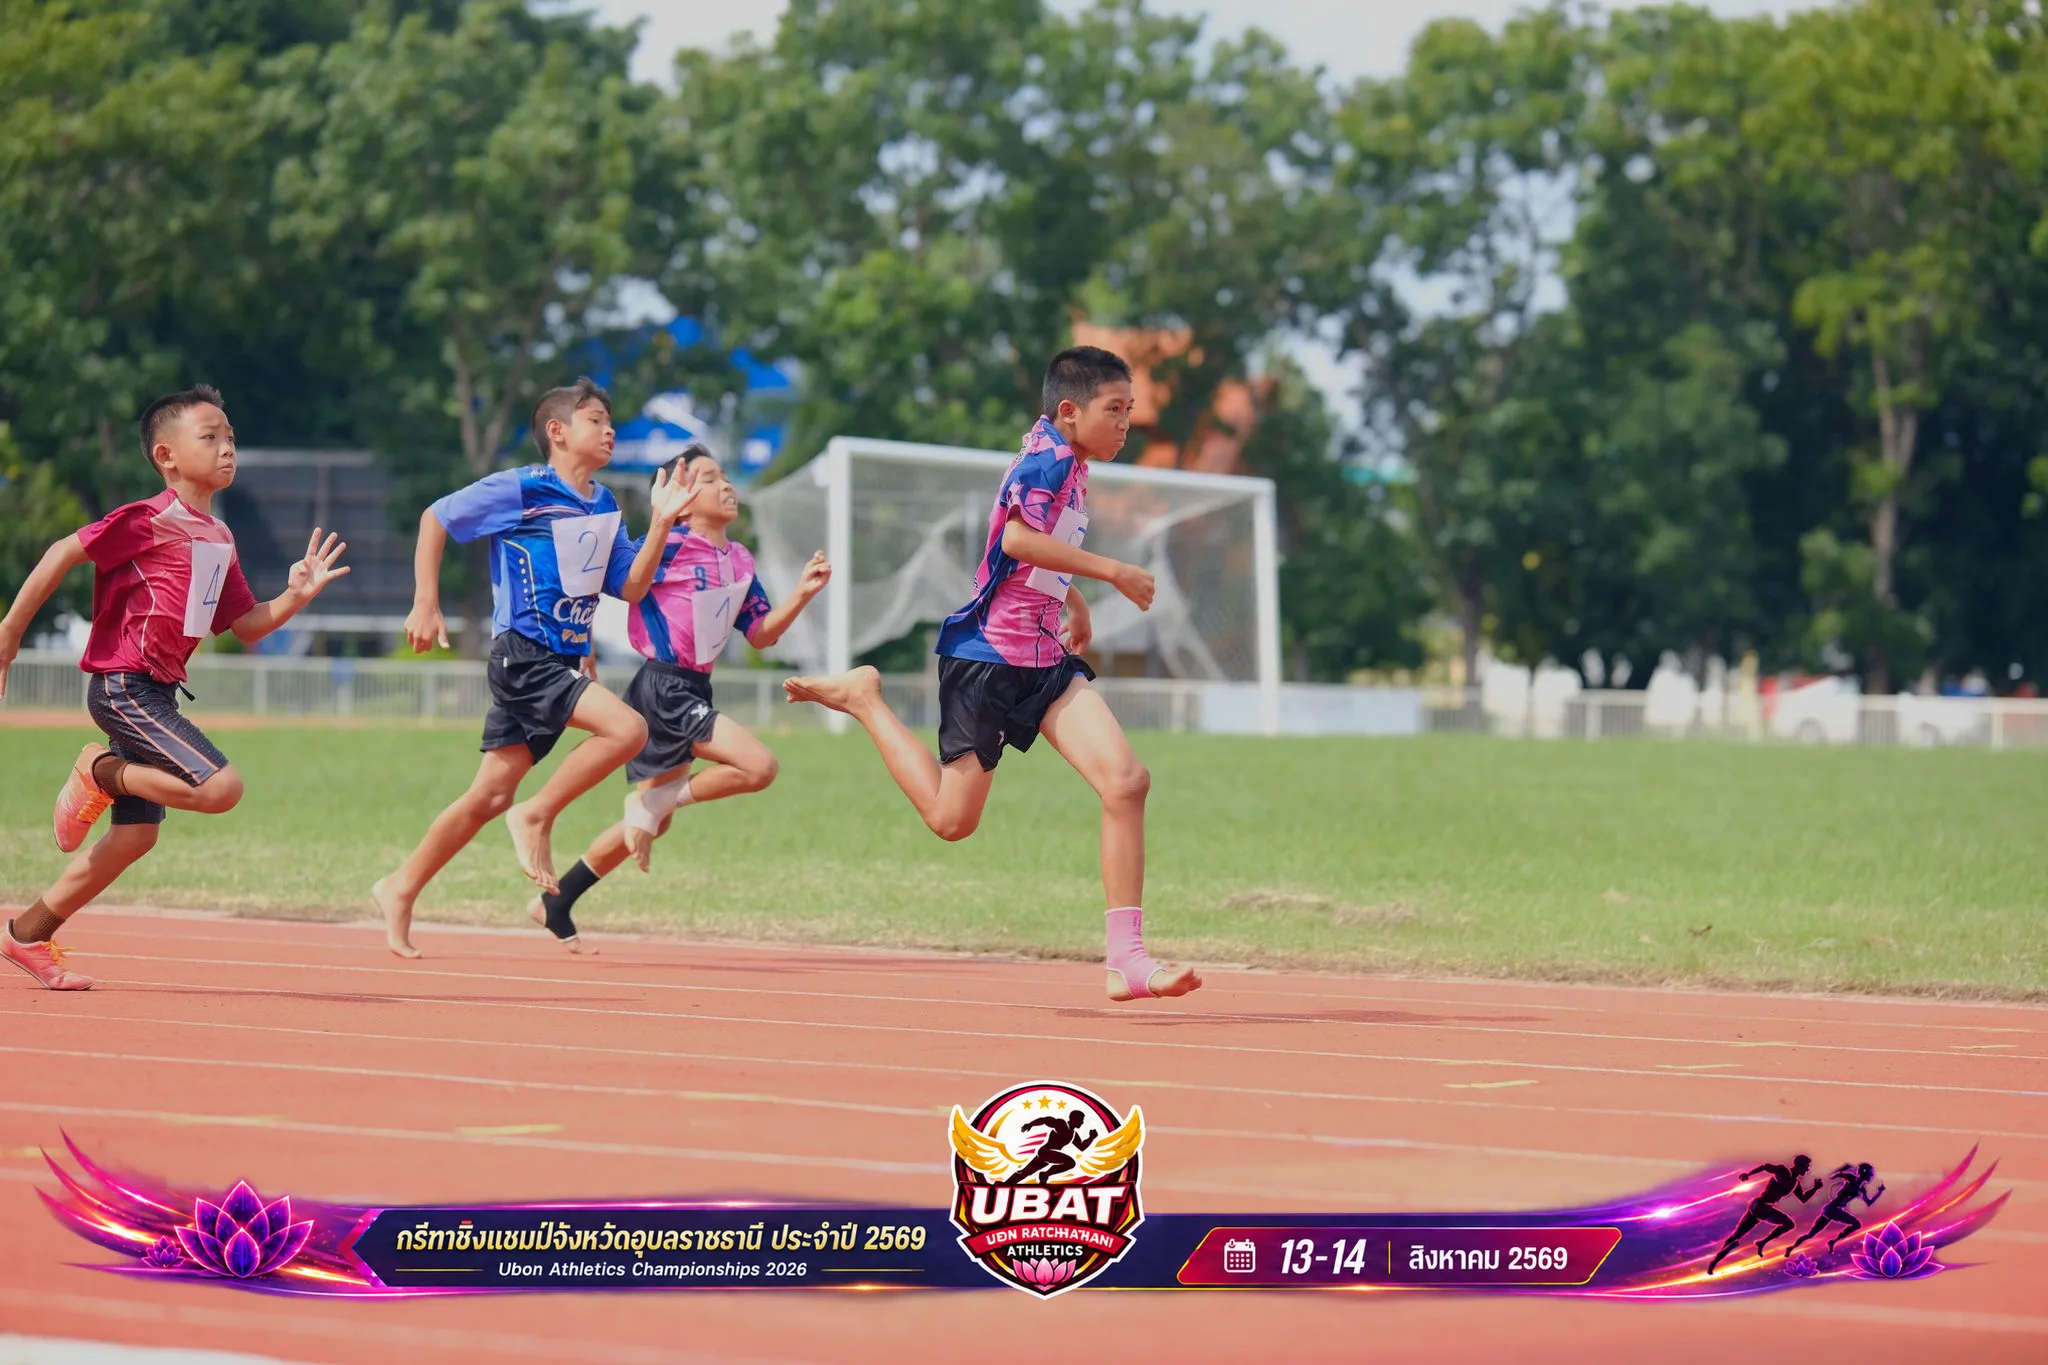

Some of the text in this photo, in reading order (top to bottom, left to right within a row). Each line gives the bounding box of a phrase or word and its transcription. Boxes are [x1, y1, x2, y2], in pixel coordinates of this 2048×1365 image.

[578, 530, 604, 573] 2
[203, 563, 220, 617] 4
[694, 566, 707, 591] 9
